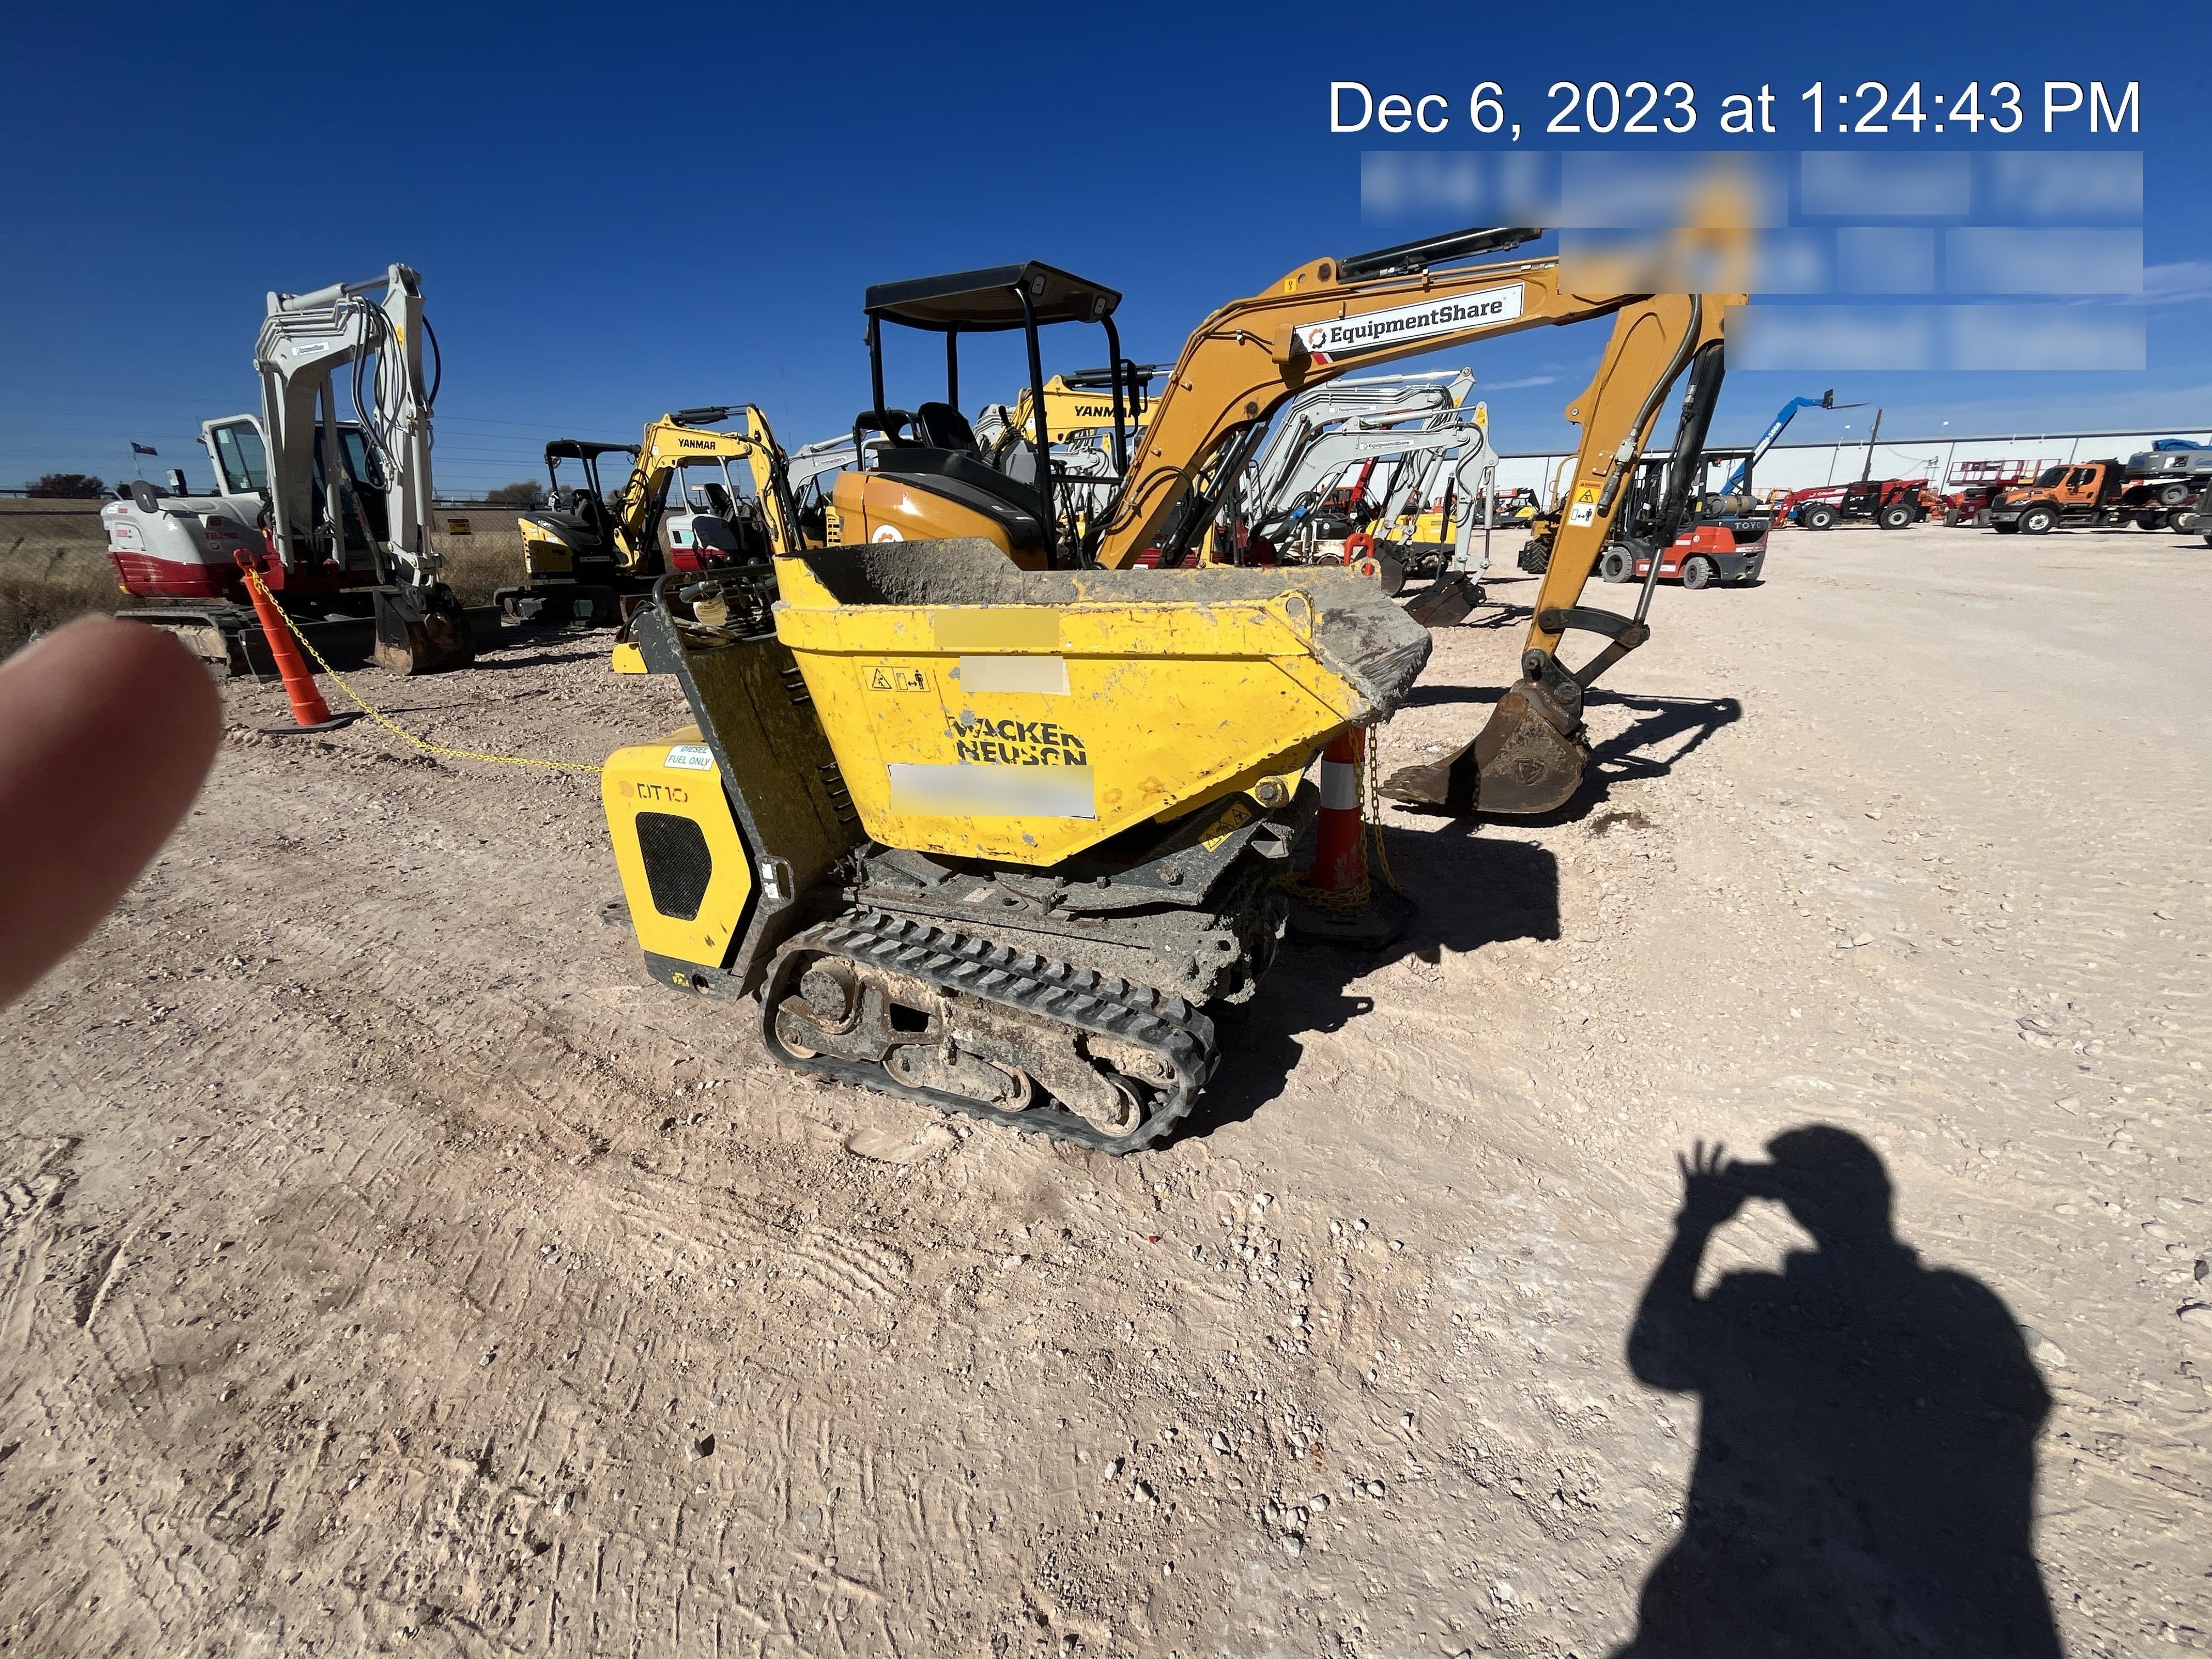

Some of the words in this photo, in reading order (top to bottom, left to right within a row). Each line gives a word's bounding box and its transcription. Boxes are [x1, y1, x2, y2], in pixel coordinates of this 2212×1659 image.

[1330, 300, 1503, 344] EquipmentShare
[1075, 406, 1132, 417] YANM
[678, 438, 715, 450] YANMAR
[680, 746, 708, 754] DIESEL
[668, 755, 686, 764] FUEL
[689, 757, 712, 766] ONLY
